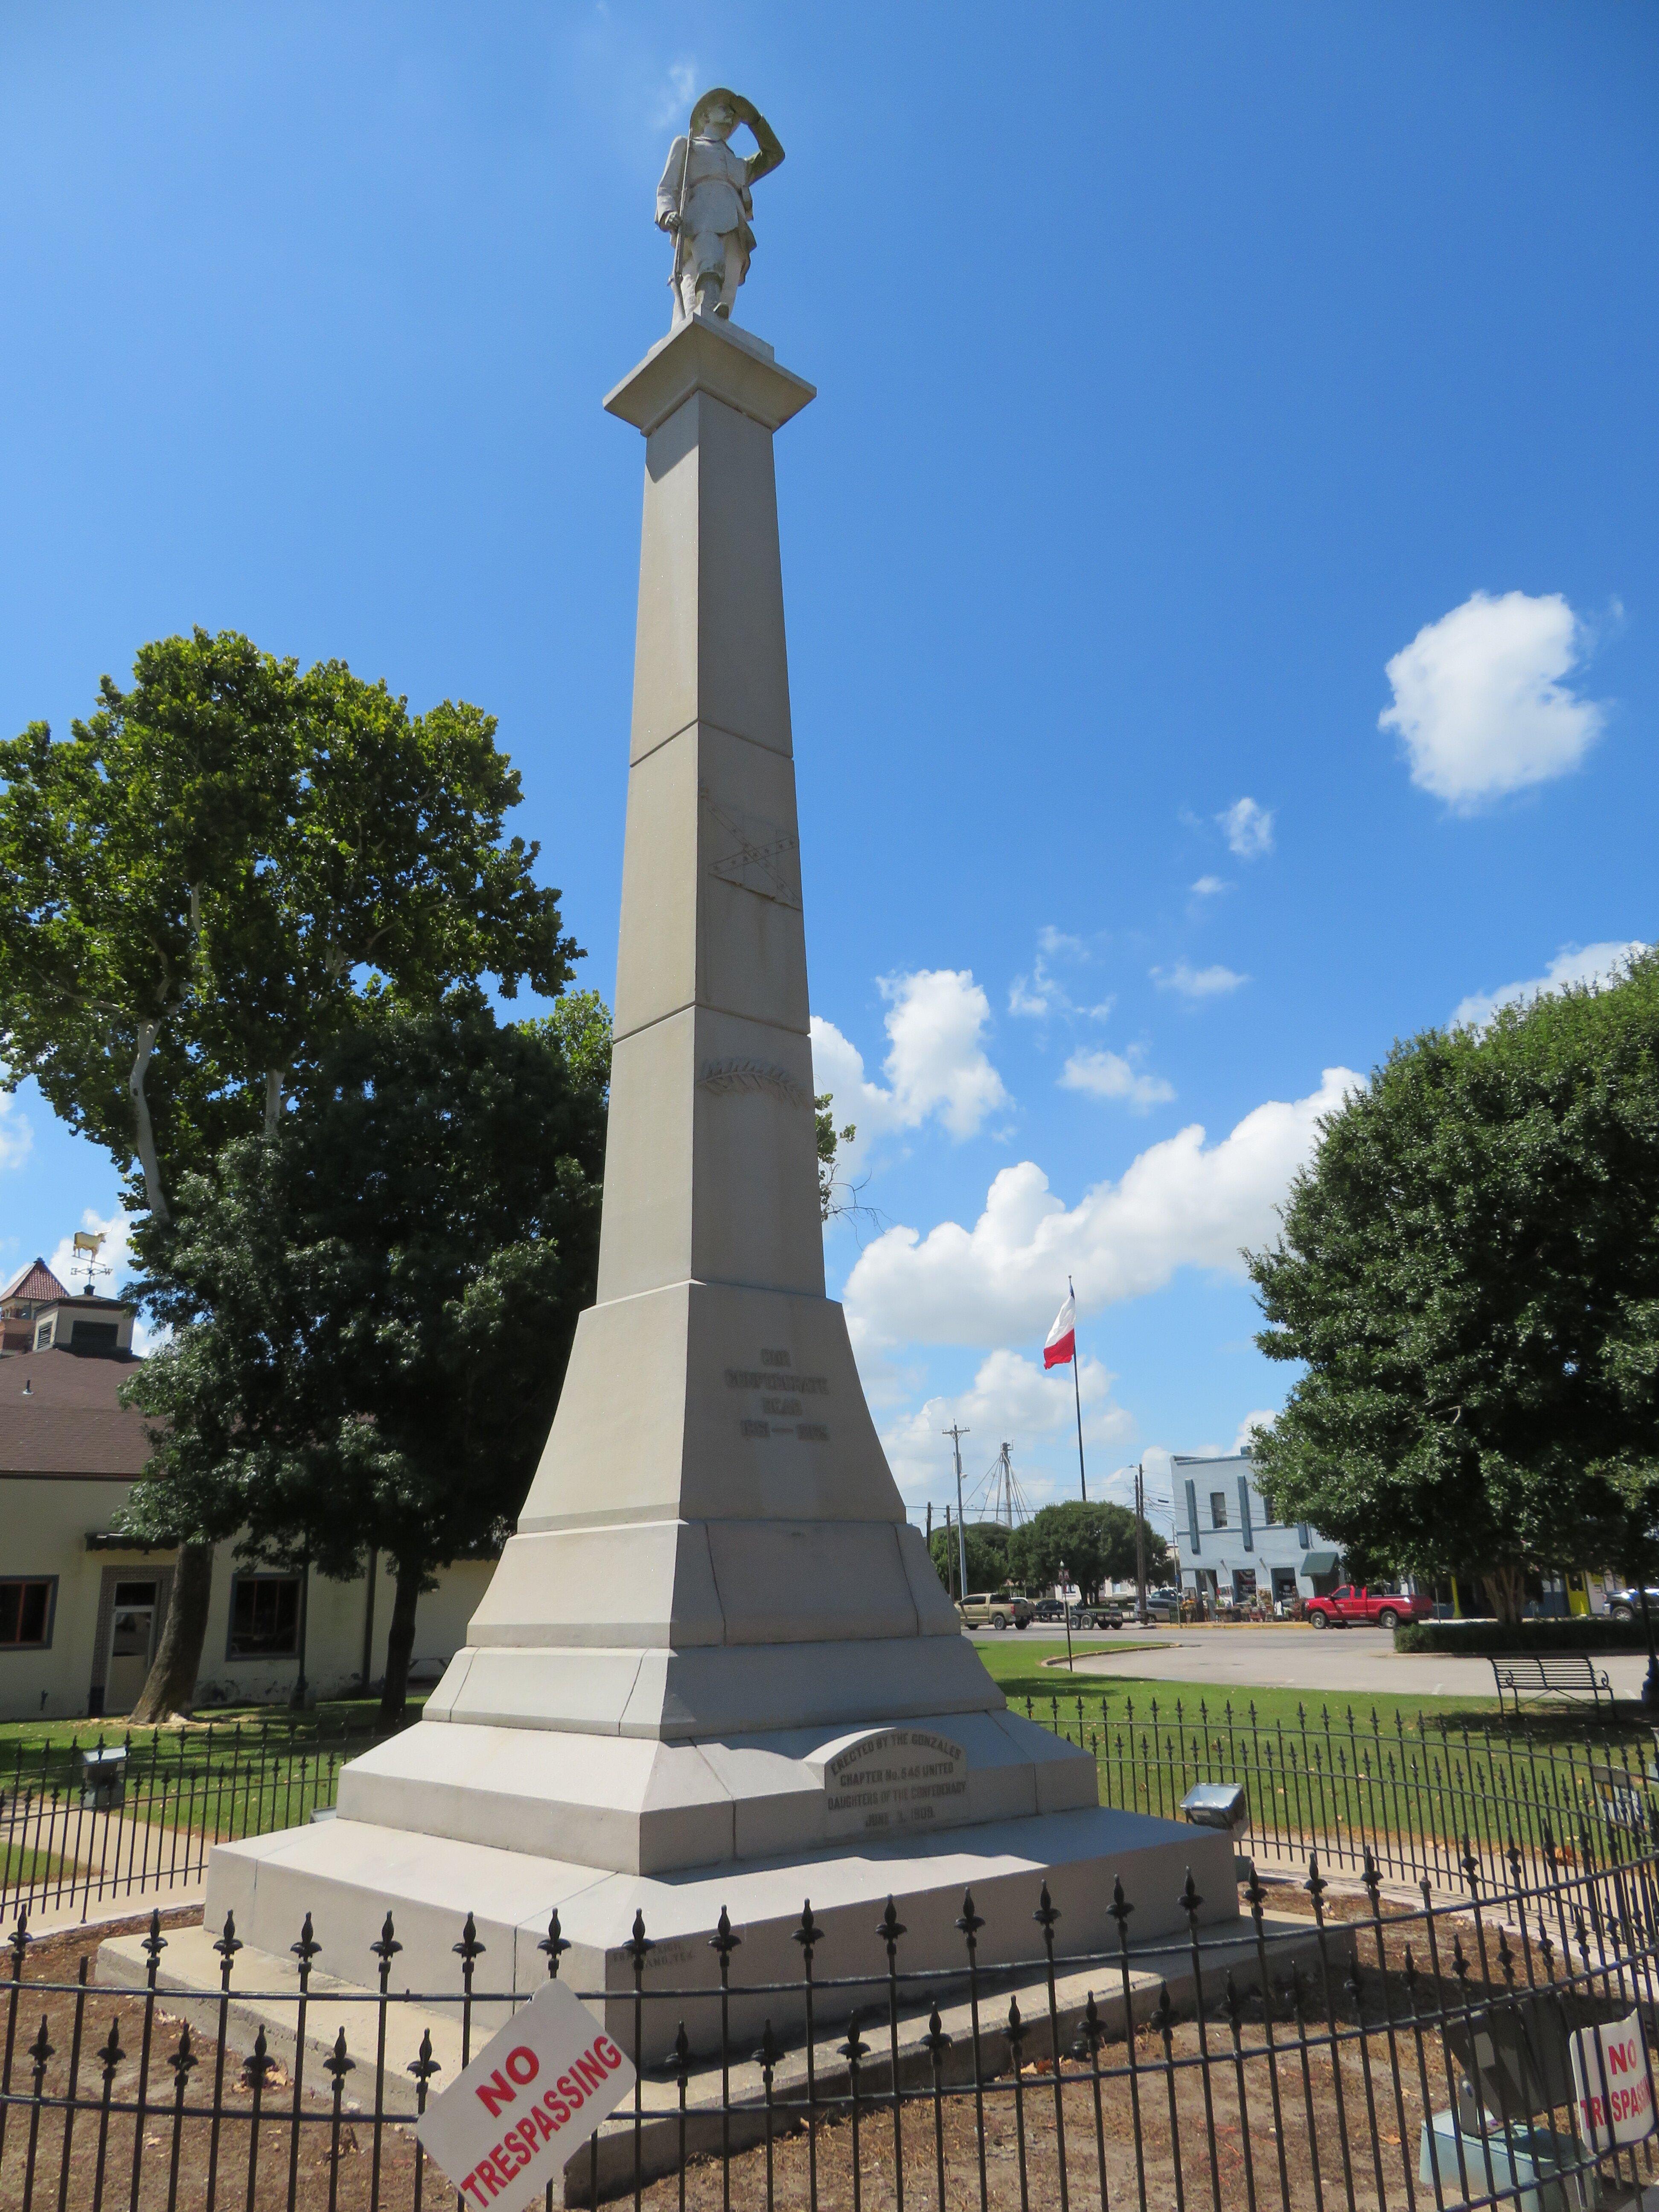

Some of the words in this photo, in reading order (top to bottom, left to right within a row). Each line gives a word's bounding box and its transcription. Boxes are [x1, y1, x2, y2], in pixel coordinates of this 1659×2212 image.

[830, 1740, 874, 1776] ERECTED
[876, 1736, 888, 1749] BY
[891, 1733, 908, 1745] THE
[912, 1734, 961, 1760] GONZALES
[840, 1770, 882, 1787] CHAPTER
[923, 1762, 953, 1777] UNITED
[828, 1792, 878, 1810] DAUGHTERS
[881, 1790, 891, 1803] OF
[893, 1787, 908, 1802] THE
[911, 1781, 966, 1799] CONFEDERACY
[865, 1813, 889, 1827] JUNE
[1608, 2038, 1637, 2075] NO
[475, 2046, 539, 2118] NO
[460, 2035, 622, 2207] TRESPASSING
